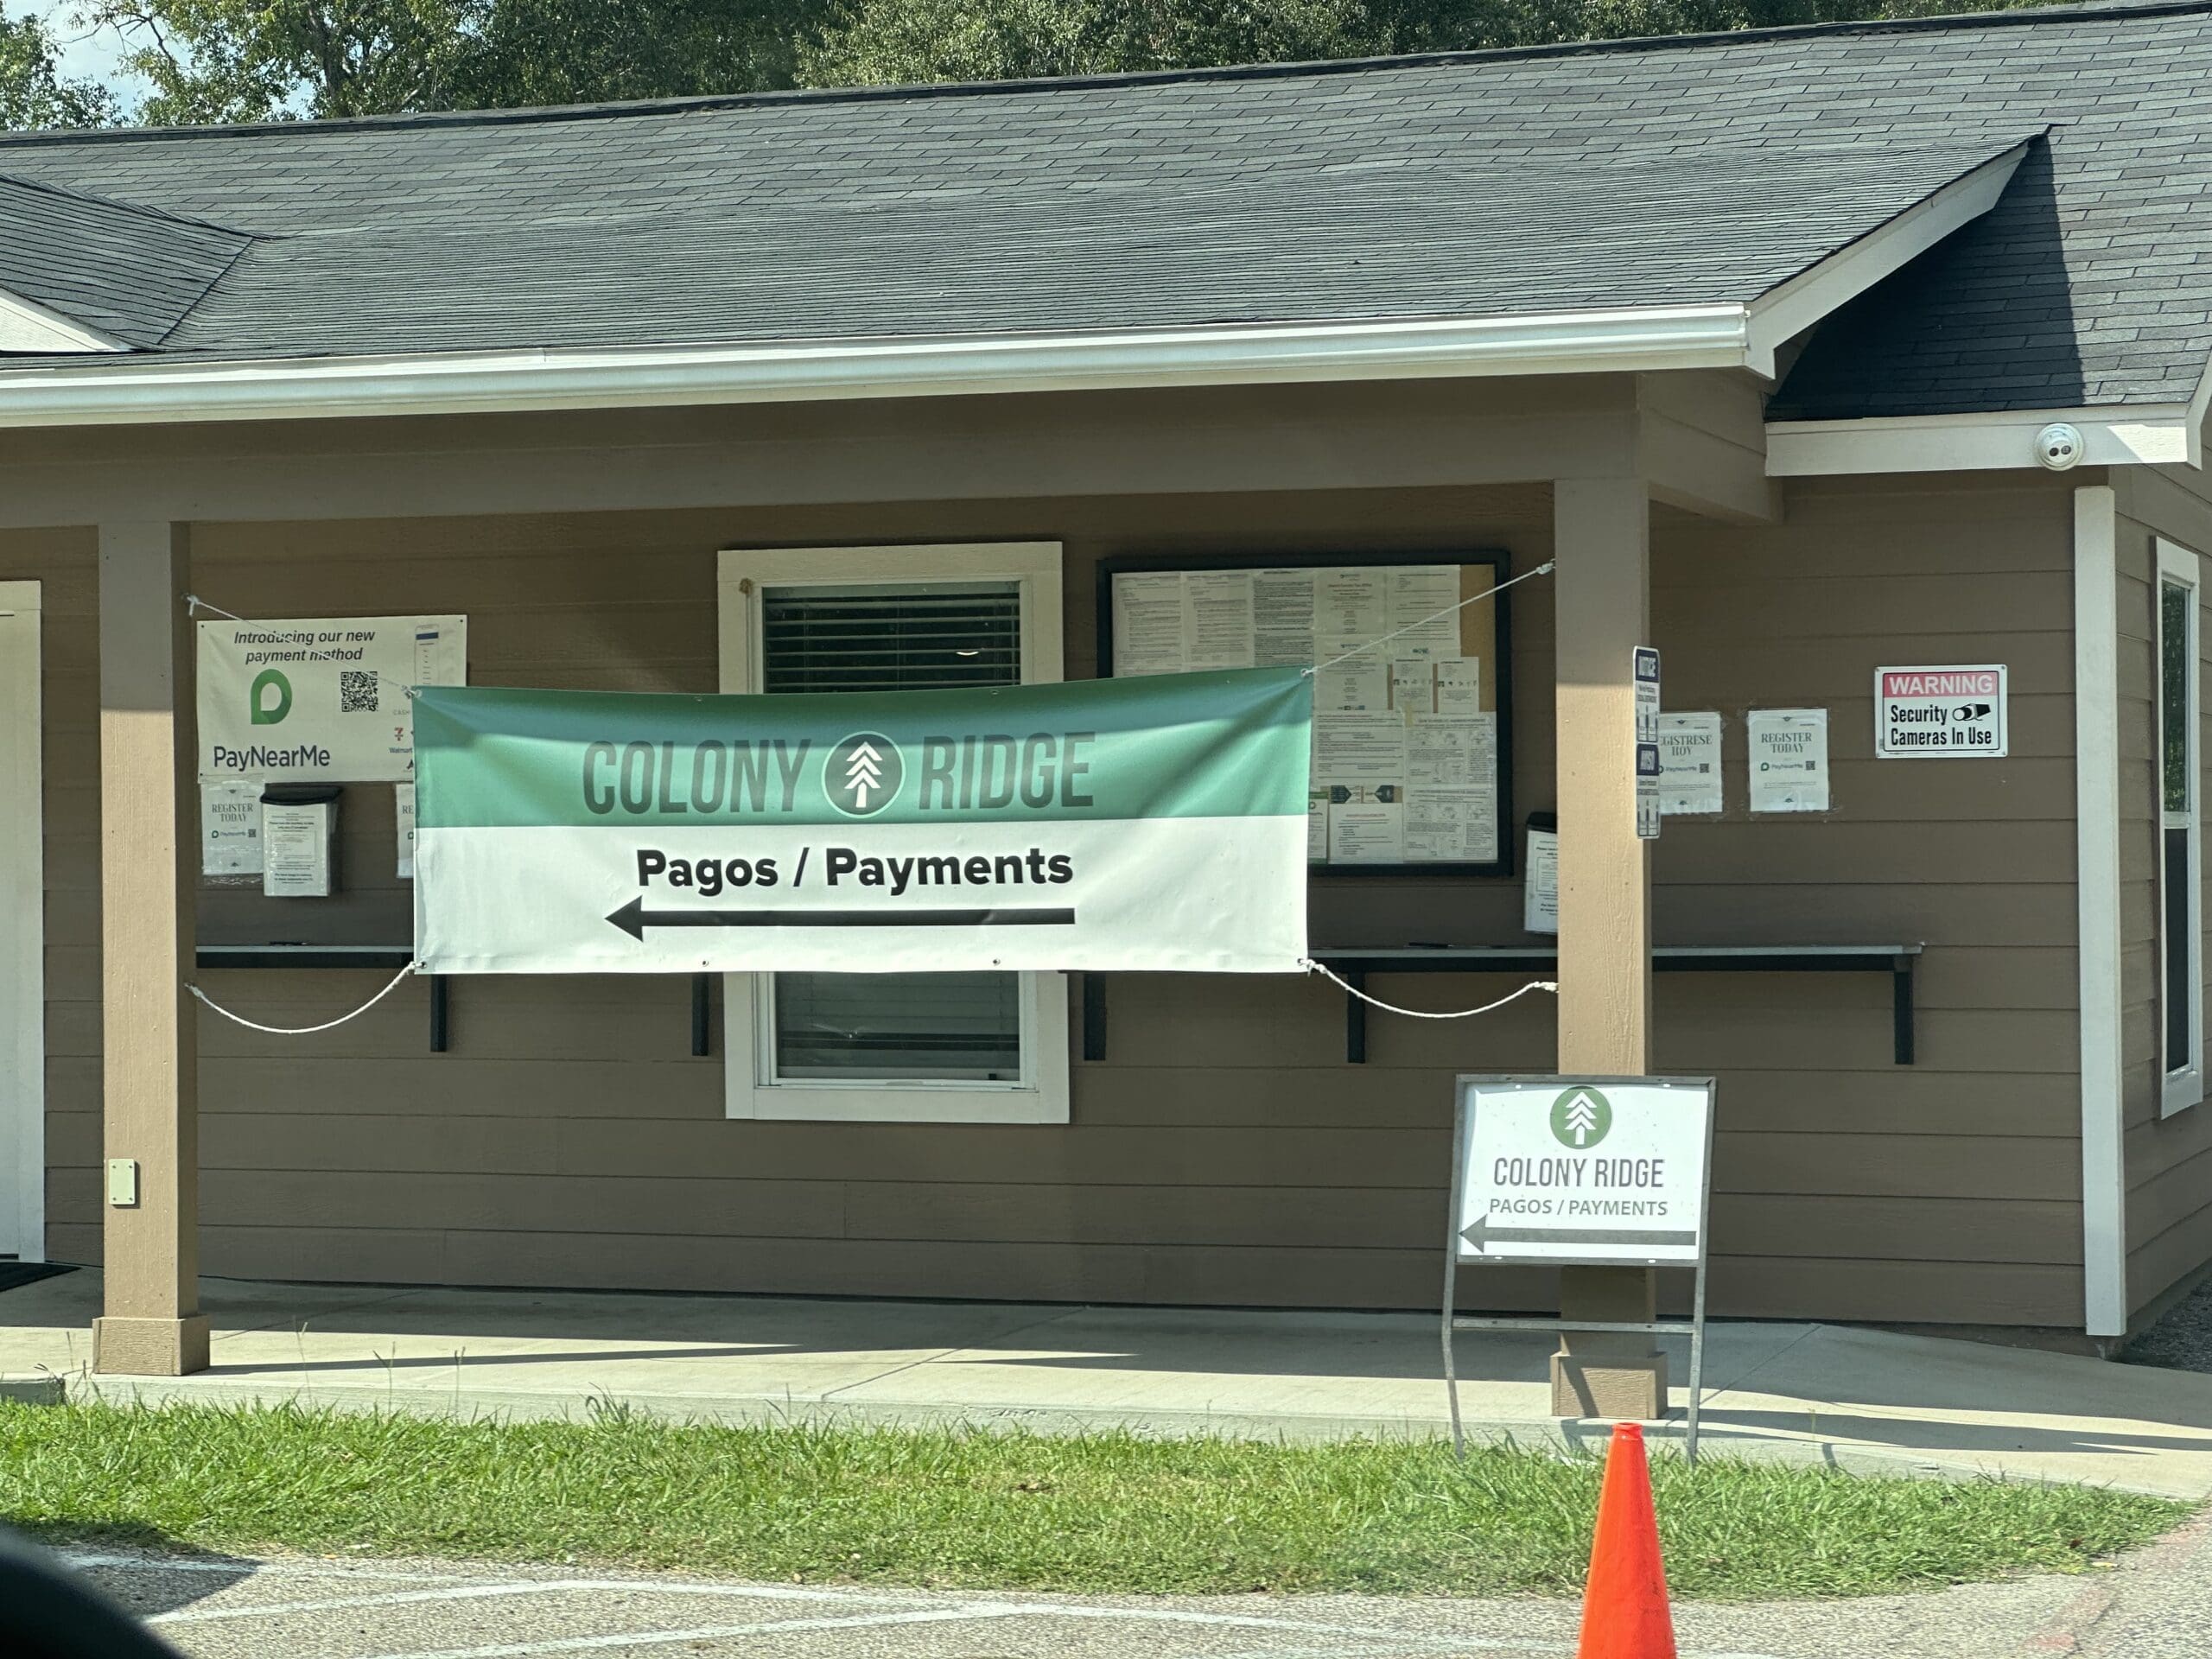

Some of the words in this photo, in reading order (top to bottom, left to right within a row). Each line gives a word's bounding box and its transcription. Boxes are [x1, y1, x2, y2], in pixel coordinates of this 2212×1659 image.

[234, 630, 315, 645] Introducing
[318, 633, 343, 643] our
[346, 631, 376, 643] new
[245, 651, 307, 664] payment
[309, 647, 364, 661] method
[1889, 674, 1993, 695] WARNING
[1891, 704, 1948, 726] Security
[1761, 732, 1812, 743] REGISTER
[1891, 728, 1947, 746] Cameras
[1952, 727, 1964, 745] In
[1968, 727, 1992, 745] Use
[1672, 746, 1693, 756] HOY
[1770, 743, 1805, 753] TODAY
[213, 745, 330, 772] PayNearMe
[583, 739, 811, 814] COLONY
[918, 731, 1096, 810] RIDGE
[212, 803, 253, 813] REGISTER
[219, 813, 246, 822] TODAY
[637, 849, 779, 896] Pagos
[793, 847, 810, 887] /
[825, 847, 1074, 896] Payments
[1494, 1157, 1587, 1186] COLONY
[1594, 1159, 1665, 1188] RIDGE
[1490, 1198, 1553, 1214] PAGOS
[1557, 1199, 1565, 1215] /
[1568, 1199, 1669, 1216] PAYMENTS
